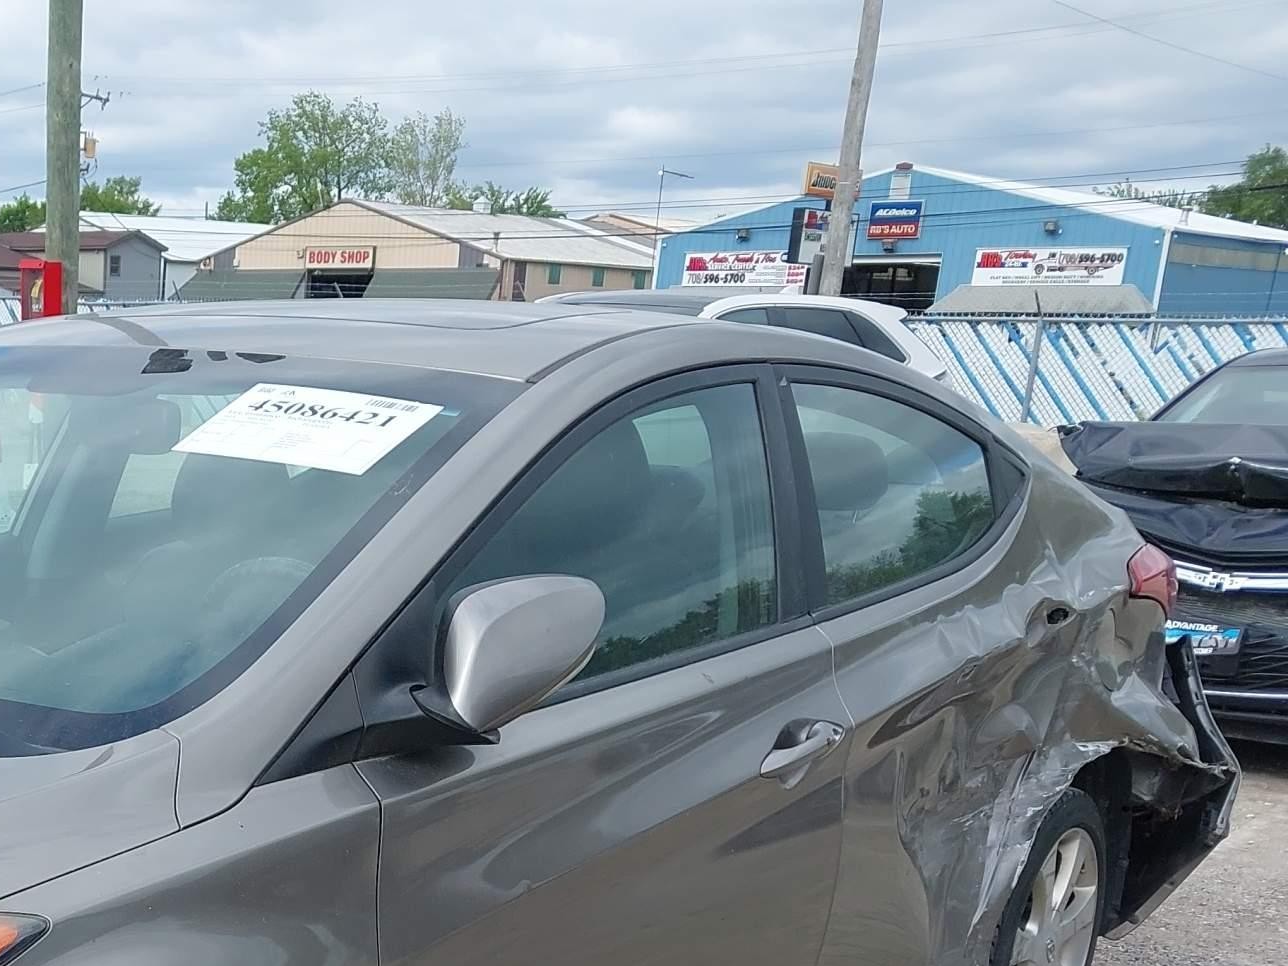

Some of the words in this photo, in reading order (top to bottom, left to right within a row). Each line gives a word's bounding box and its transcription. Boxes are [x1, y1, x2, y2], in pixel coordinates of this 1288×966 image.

[890, 224, 916, 233] AUTO
[309, 250, 337, 265] BODY
[340, 250, 370, 264] SHOP
[687, 272, 746, 284] 708/596-5700
[248, 399, 398, 428] 45086421
[1164, 619, 1219, 632] ADVANTAGE
